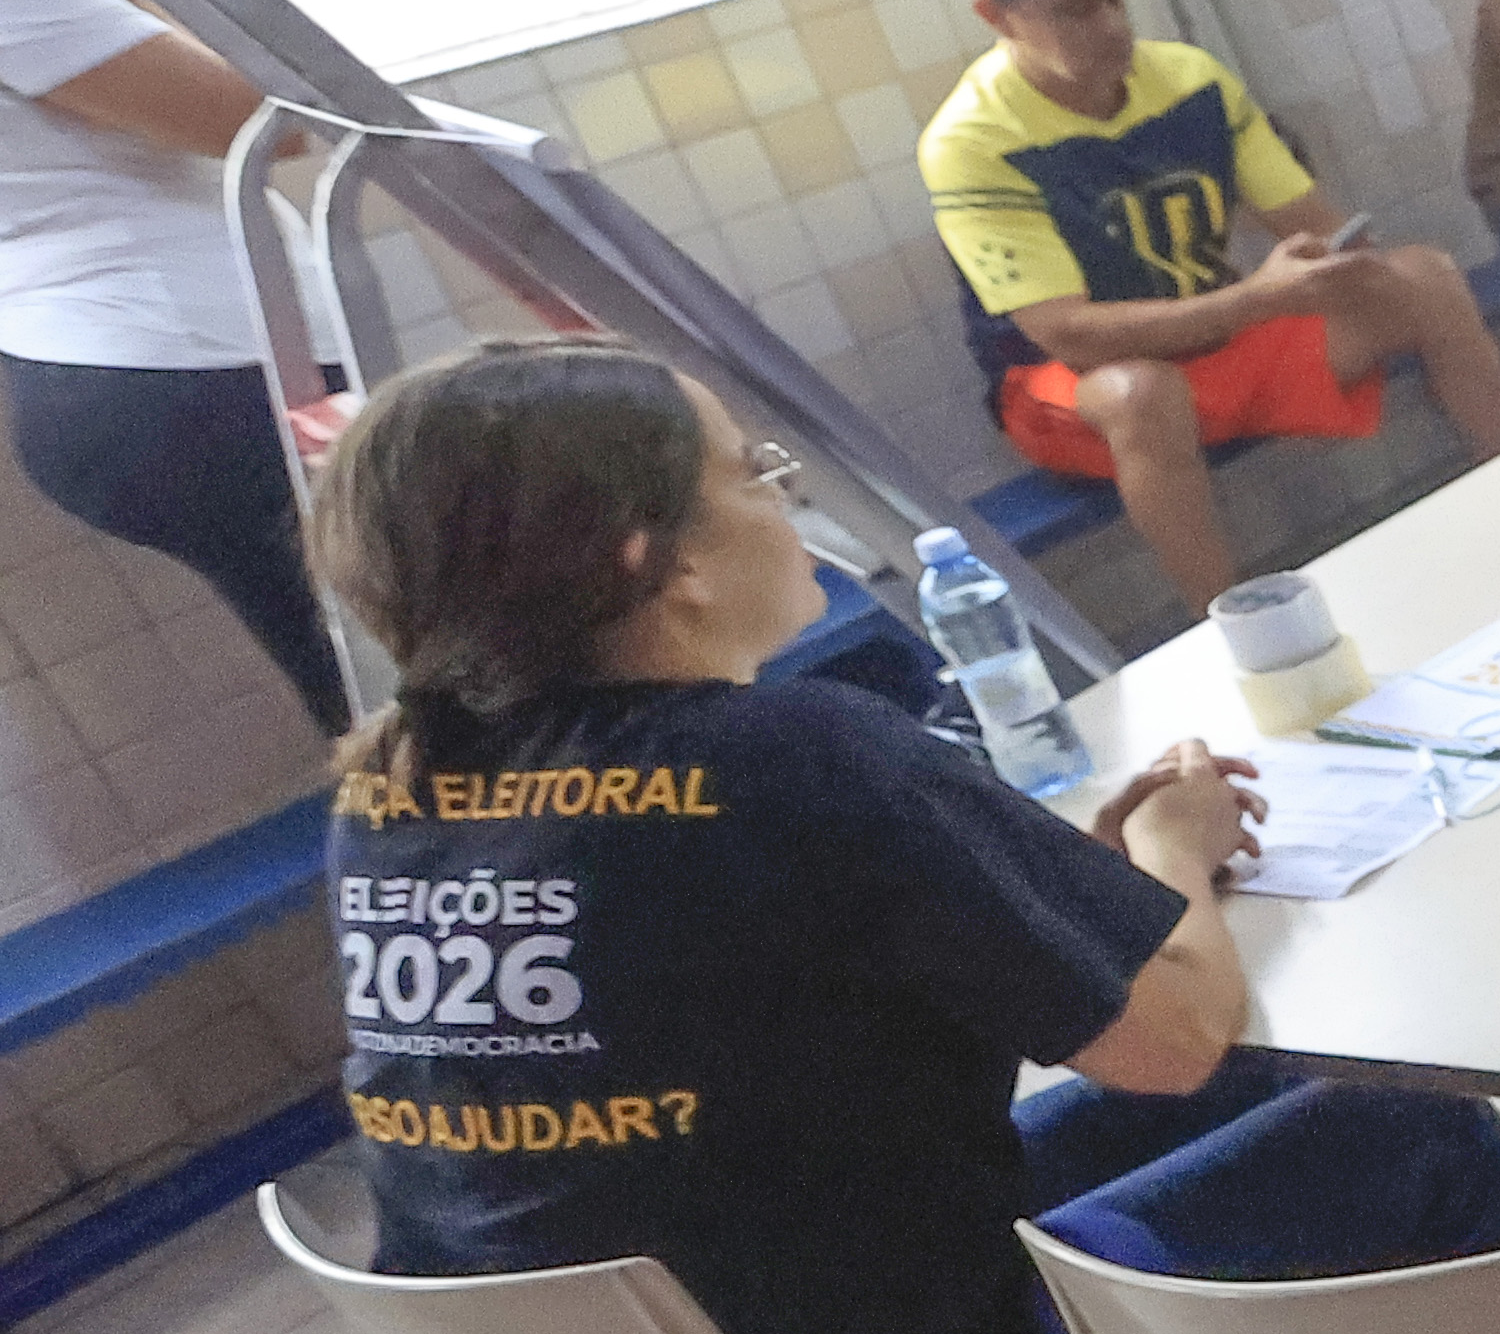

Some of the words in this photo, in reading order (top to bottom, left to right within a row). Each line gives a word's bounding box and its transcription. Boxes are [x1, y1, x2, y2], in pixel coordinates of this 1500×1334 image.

[433, 766, 720, 821] ELEITORAL
[340, 868, 579, 938] ELEIÇÕES
[342, 932, 583, 1025] 2026
